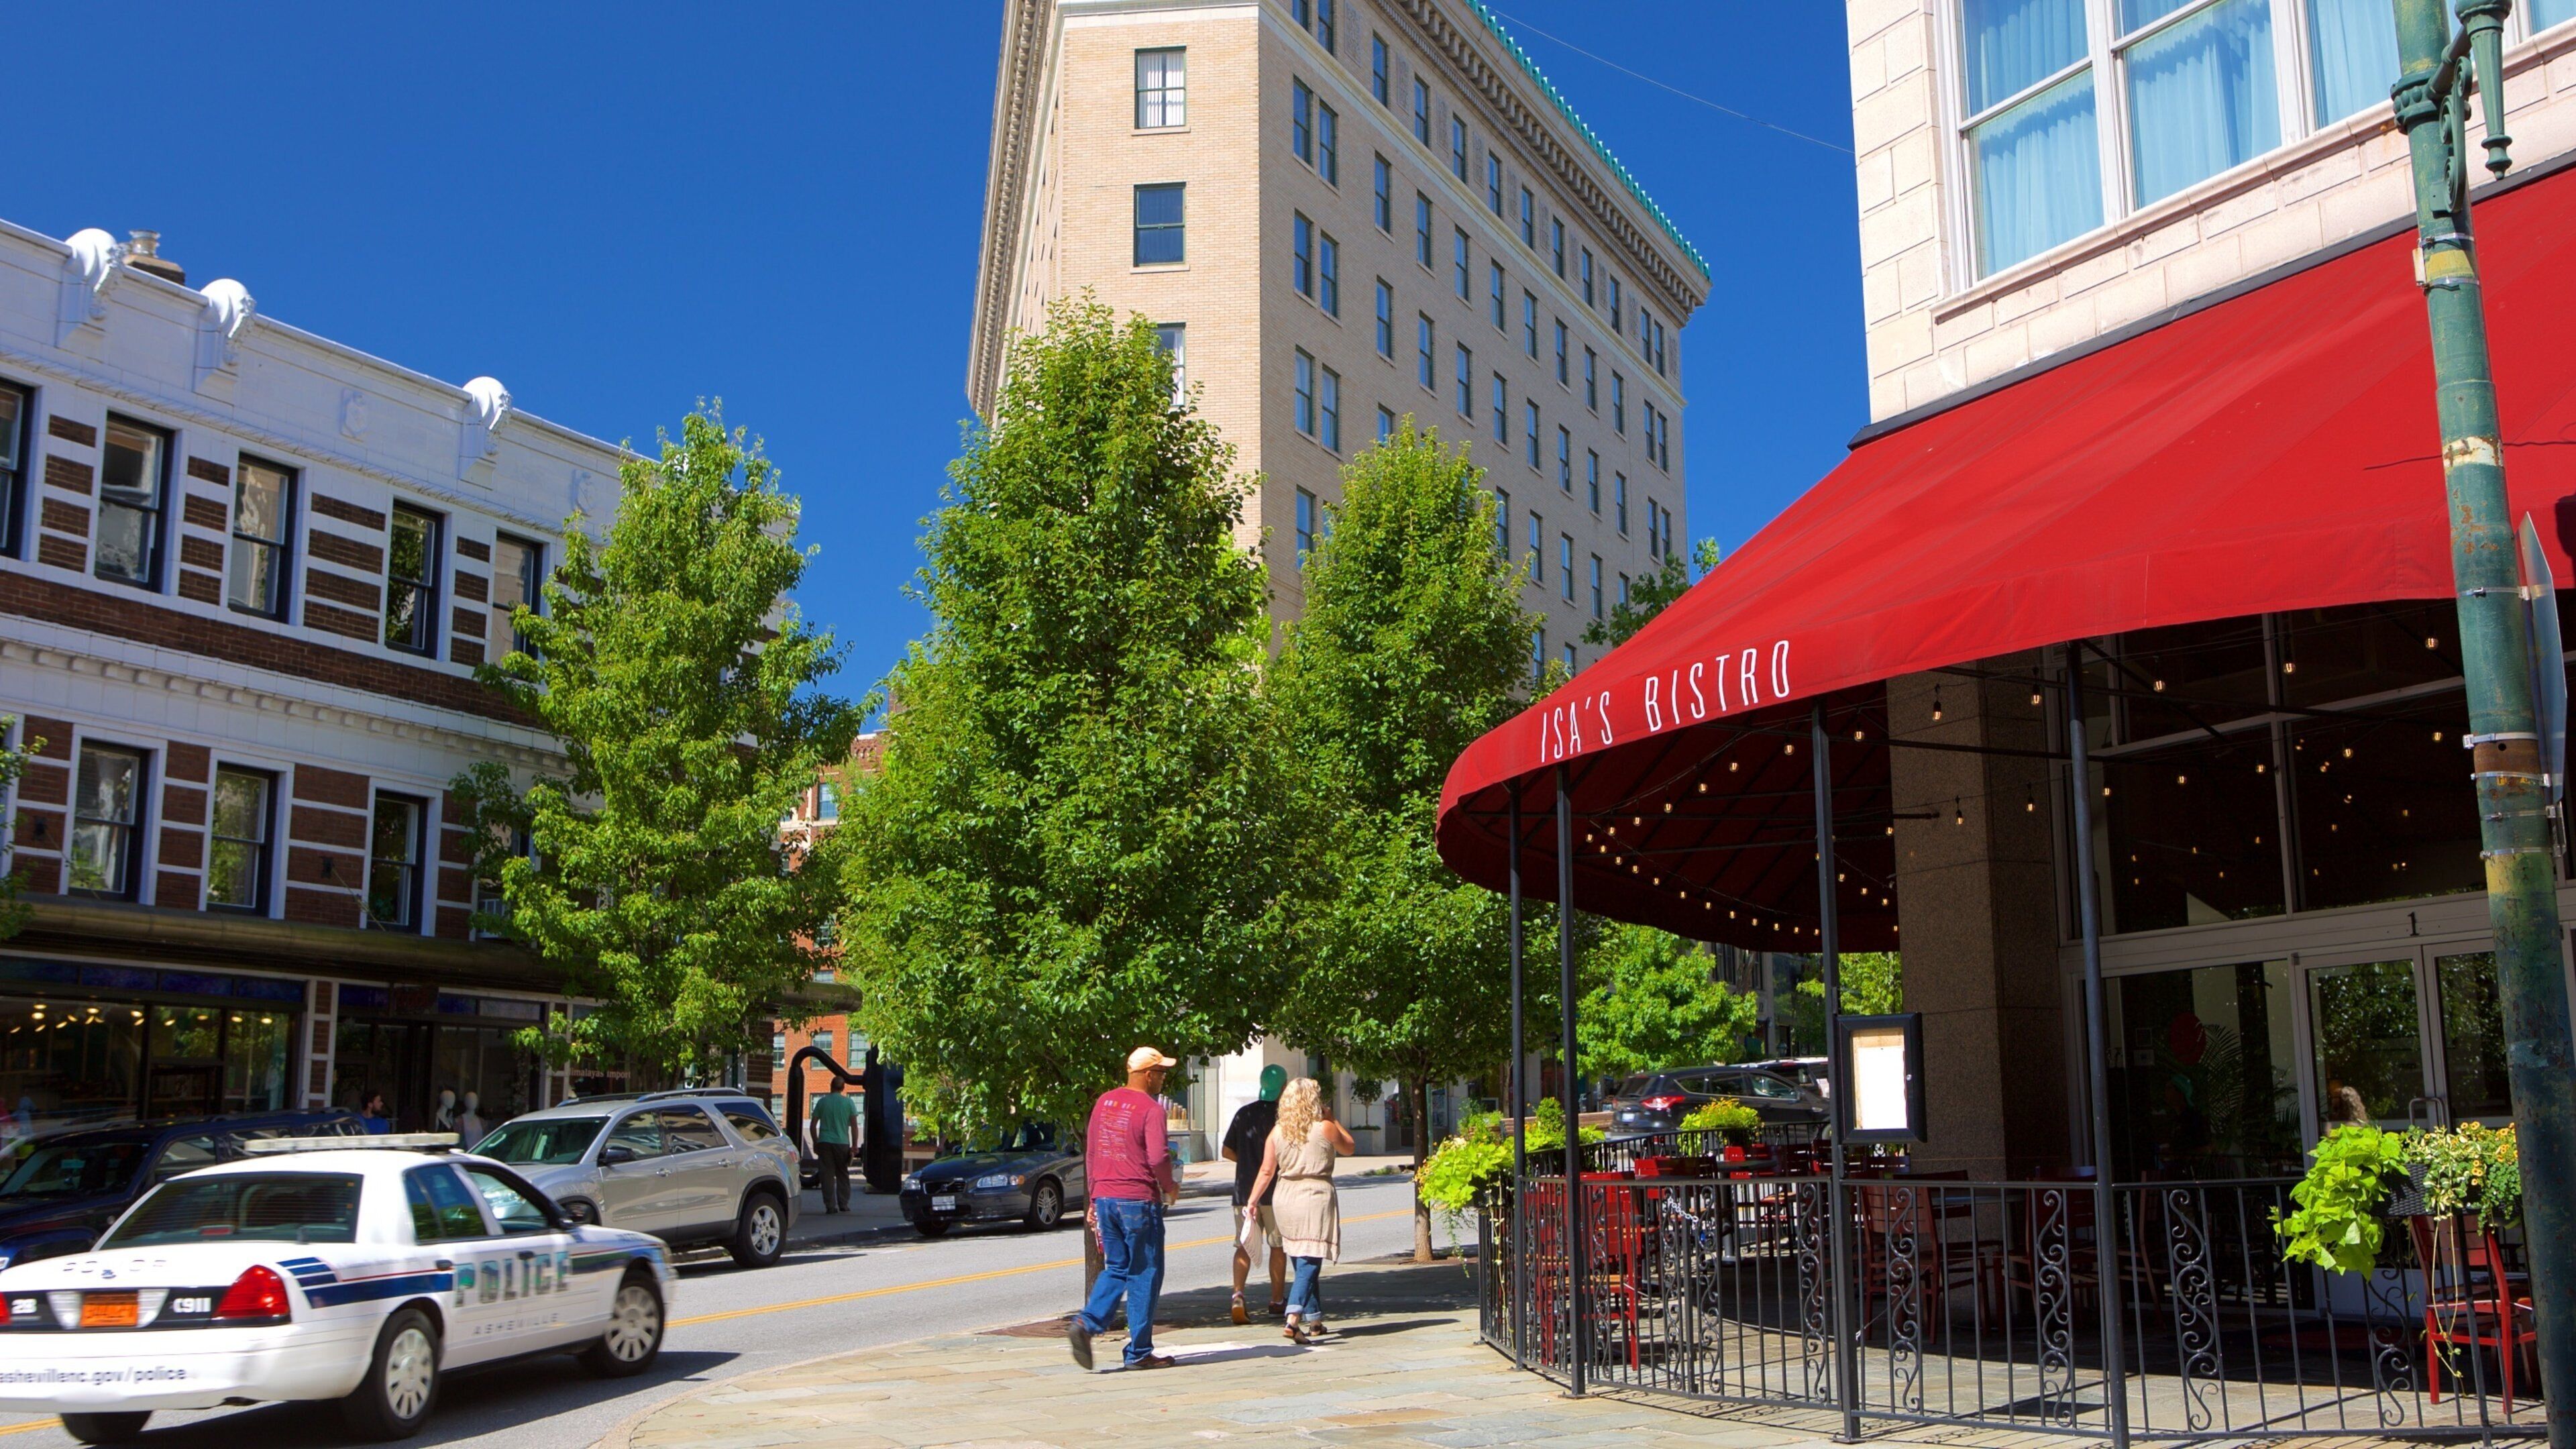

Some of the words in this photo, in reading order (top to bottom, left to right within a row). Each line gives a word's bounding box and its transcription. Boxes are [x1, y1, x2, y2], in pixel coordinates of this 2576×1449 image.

[1541, 691, 1613, 763] ISA'S
[1645, 640, 1790, 733] BISTRO
[2407, 912, 2420, 936] 1
[455, 1252, 572, 1307] POLICE
[473, 1313, 559, 1334] ASHEVILLE
